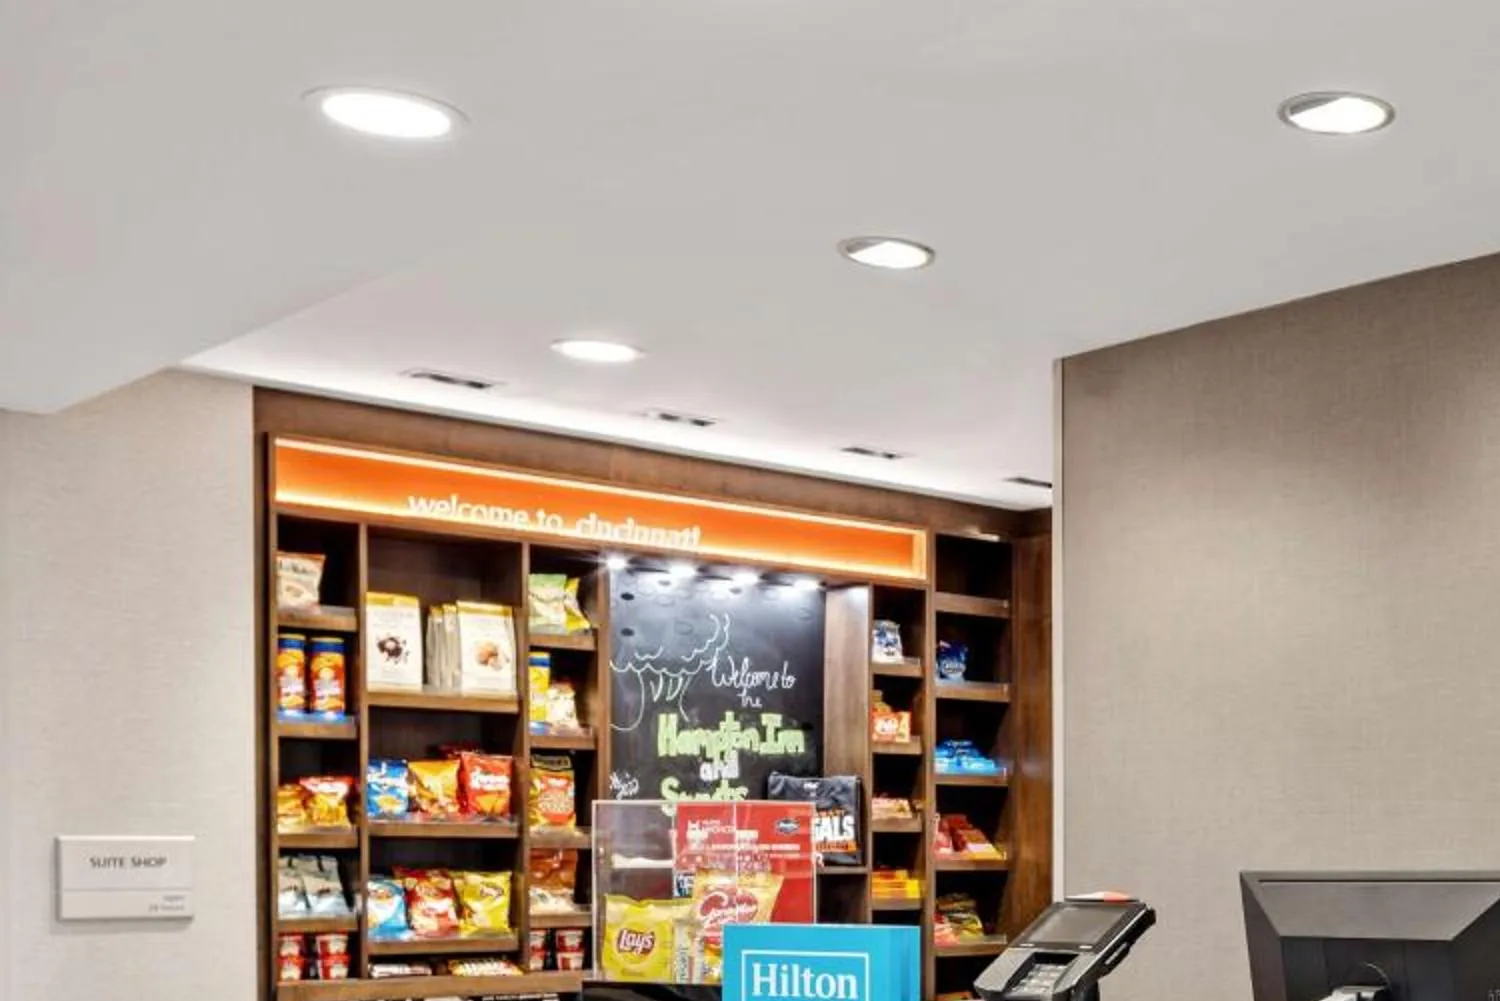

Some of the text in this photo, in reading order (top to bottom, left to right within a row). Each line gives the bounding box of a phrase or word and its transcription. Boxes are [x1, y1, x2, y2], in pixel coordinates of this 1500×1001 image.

[408, 494, 529, 530] welcome
[536, 508, 563, 531] to
[657, 710, 759, 761] Hampton
[701, 750, 739, 782] and
[89, 856, 168, 869] SUITE SHOP
[751, 962, 859, 1000] Hilton
